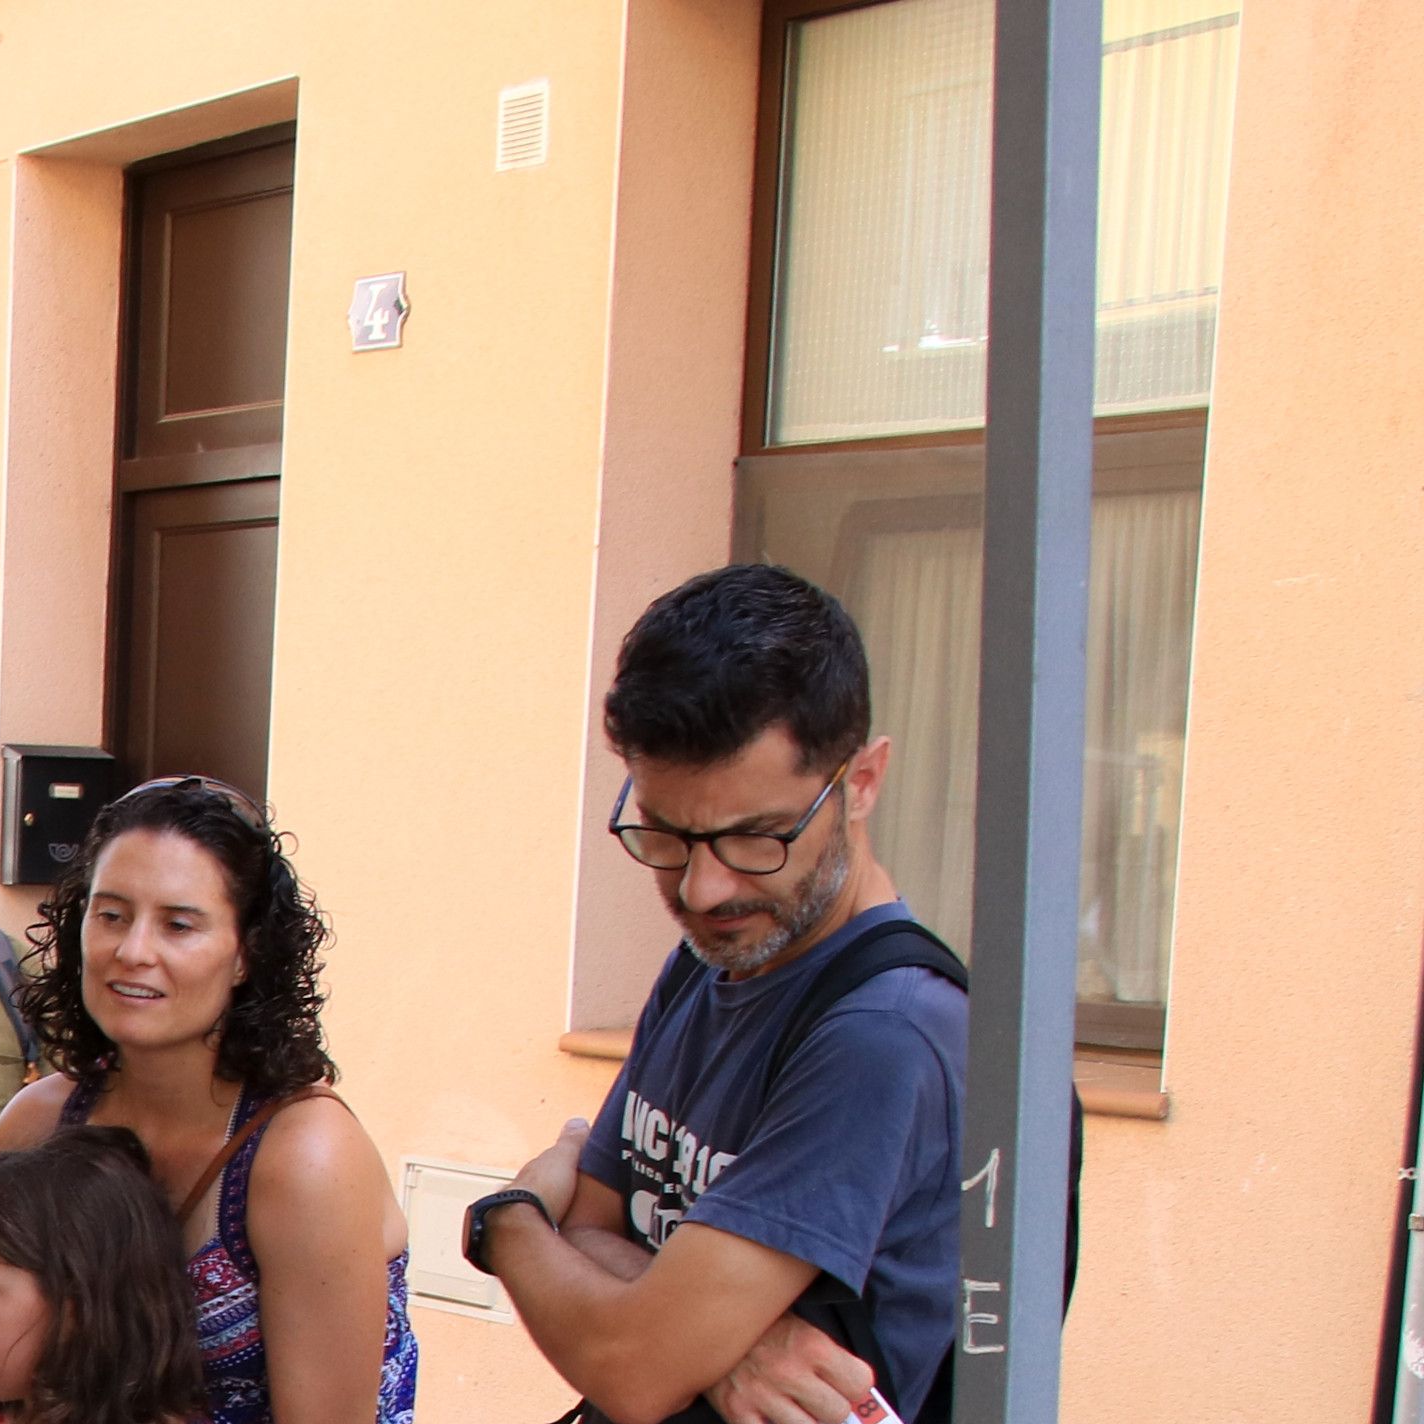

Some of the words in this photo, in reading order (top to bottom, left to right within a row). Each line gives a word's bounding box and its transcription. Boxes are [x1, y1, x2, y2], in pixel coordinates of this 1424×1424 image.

[363, 283, 390, 341] 4
[960, 1147, 1001, 1229] 1
[961, 1278, 1006, 1355] E
[857, 1399, 879, 1418] 8
